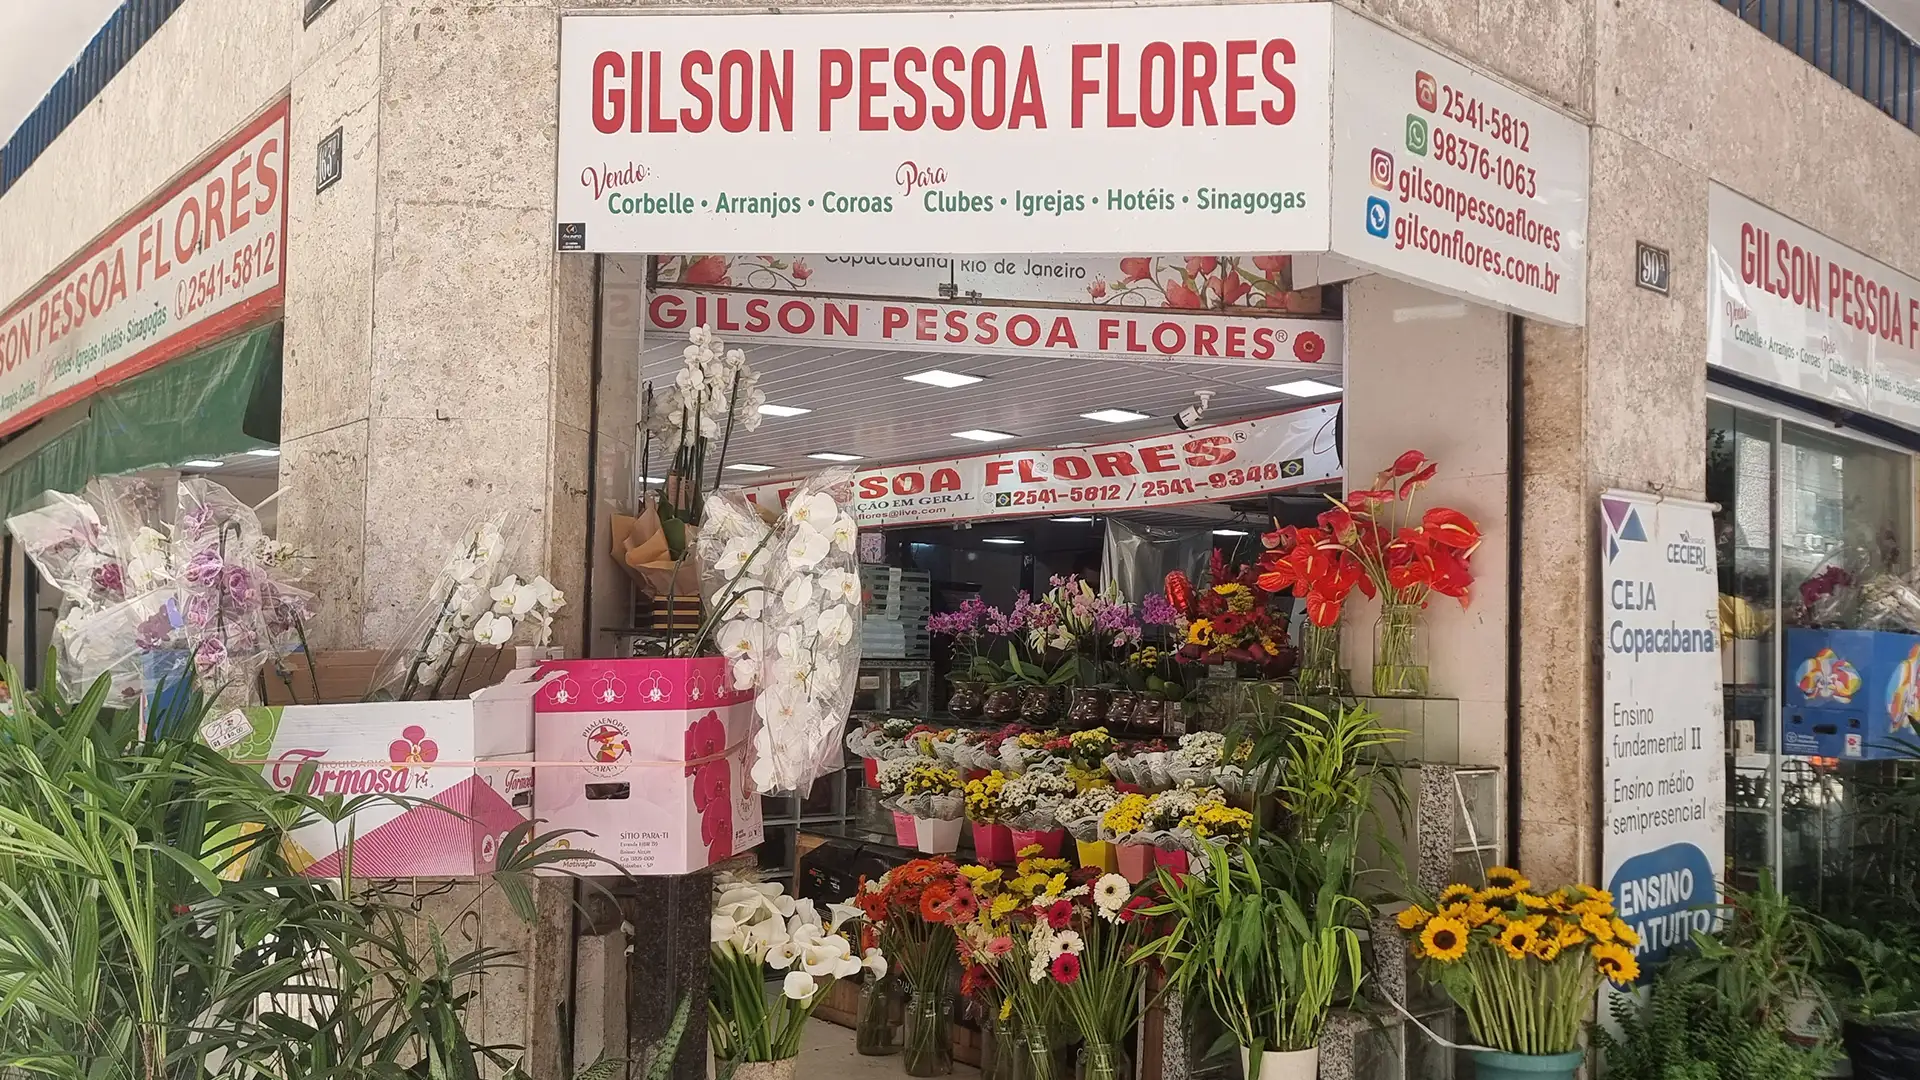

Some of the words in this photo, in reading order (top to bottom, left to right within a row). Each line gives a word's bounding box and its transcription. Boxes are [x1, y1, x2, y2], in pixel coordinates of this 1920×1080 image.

[591, 49, 794, 134] GILSON
[819, 45, 1047, 132] PESSOA
[1071, 38, 1296, 129] FLORES
[1442, 84, 1530, 153] 2541-5812
[581, 161, 651, 200] Vendo:
[896, 160, 948, 197] Para
[1433, 127, 1537, 198] 98376-1063
[608, 192, 694, 215] Corbelle
[715, 192, 801, 219] Arranjos
[822, 191, 893, 214] Coroas
[923, 189, 994, 213] Clubes
[1015, 189, 1085, 217] Igrejas
[1107, 187, 1175, 212] Hotéis
[1197, 187, 1306, 215] Sinagogas
[1399, 165, 1561, 252] gilsonpessoaflores
[37, 247, 127, 353] PESSOA
[136, 138, 278, 291] FLORES
[1394, 212, 1561, 294] gilsonflores.com.br
[188, 232, 276, 315] 2541-5812
[994, 258, 1016, 276] de
[1024, 260, 1086, 279] Janeiro
[1741, 222, 1821, 312] GILSON
[1829, 260, 1904, 345] PESSOA
[649, 294, 858, 337] GILSON
[882, 306, 1079, 349] PESSOA
[1735, 324, 1762, 349] Corbelle
[1769, 336, 1796, 361] Arranjos
[892, 498, 915, 507] EM
[918, 492, 975, 505] GERAL
[1013, 483, 1121, 507] 2541-5812
[1142, 463, 1279, 499] 2541-9348
[1611, 579, 1657, 611] CEJA
[1610, 620, 1715, 662] Copacabana
[1613, 702, 1654, 728] Ensino
[1613, 727, 1687, 760] fundamental
[1691, 727, 1702, 750] II
[1613, 775, 1654, 803] Ensino
[1658, 772, 1695, 796] médio
[620, 831, 640, 840] SÍTIO
[642, 831, 669, 839] PARA-TI
[1613, 797, 1707, 835] semipresencial
[1620, 868, 1694, 917] ENSINO
[1632, 909, 1711, 957] ATUITO
